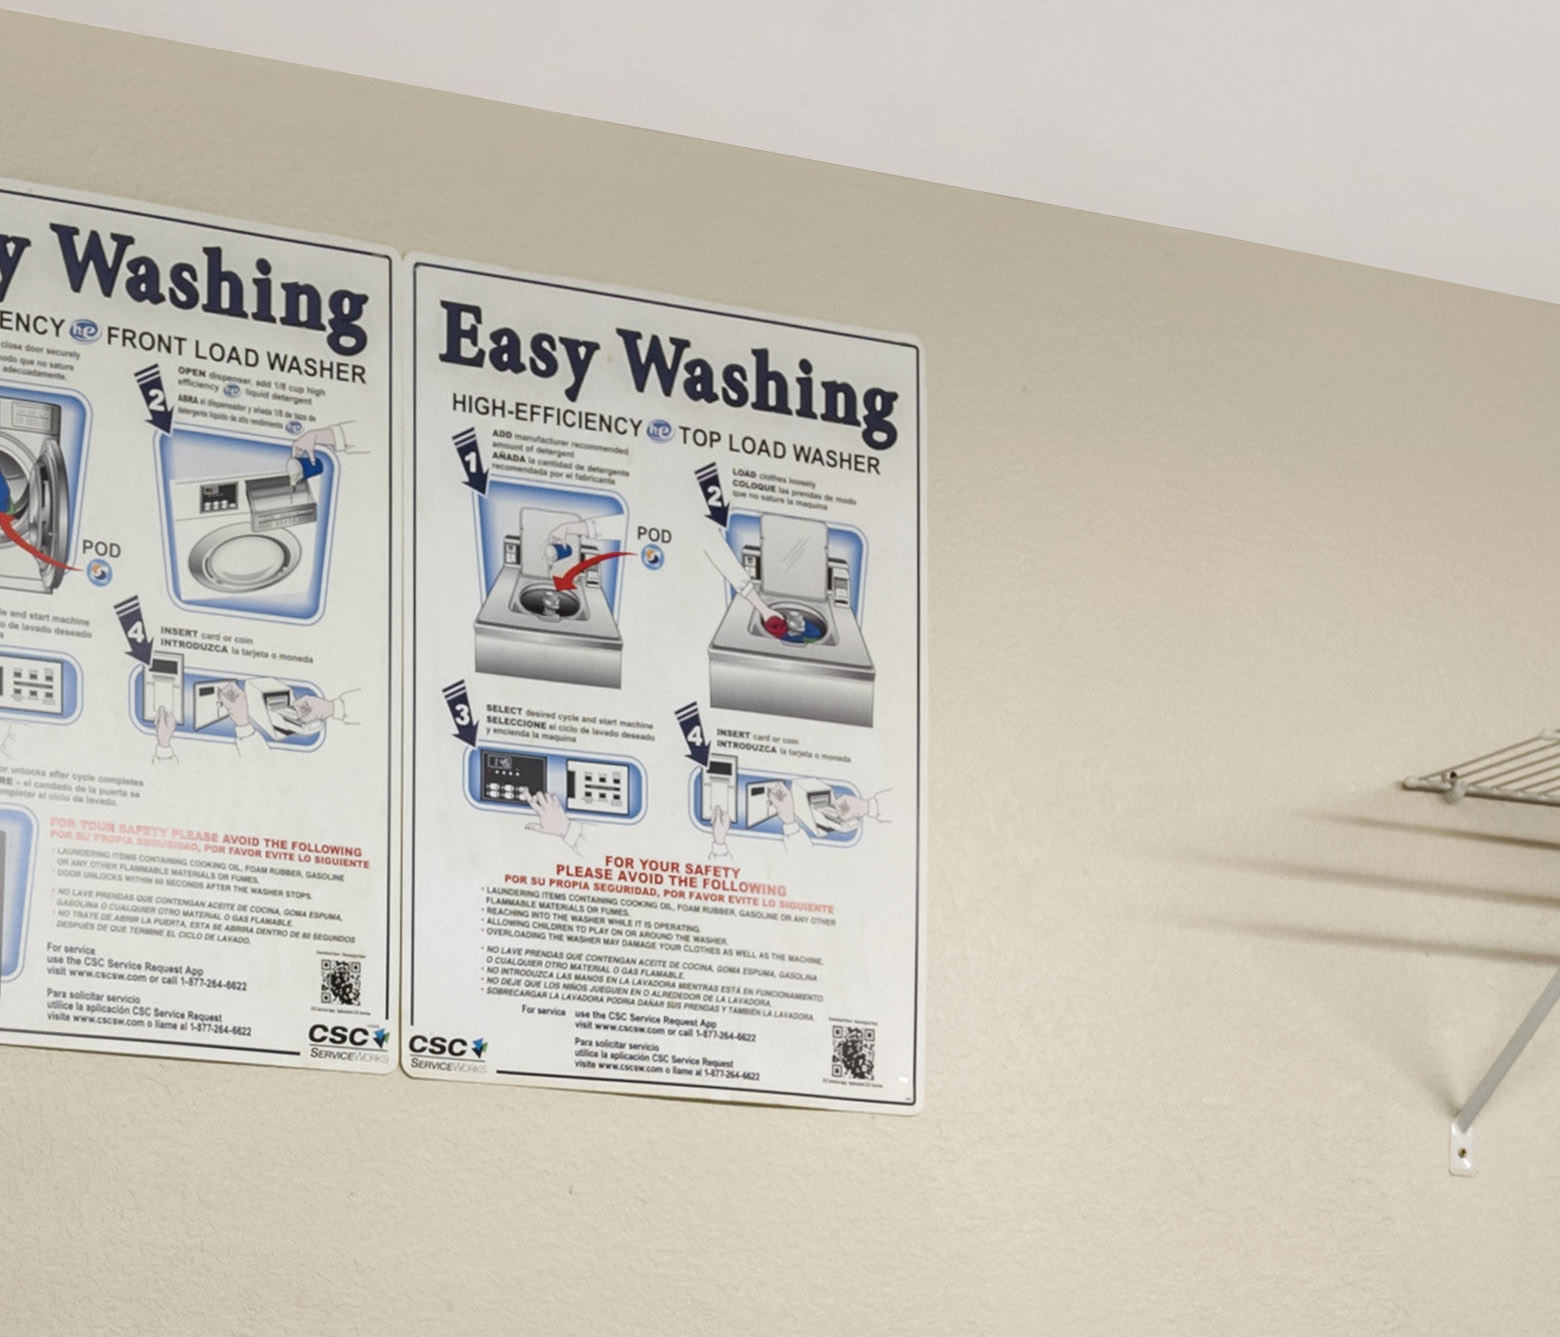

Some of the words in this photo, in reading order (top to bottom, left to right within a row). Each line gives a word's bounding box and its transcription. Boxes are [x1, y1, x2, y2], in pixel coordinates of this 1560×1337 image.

[49, 222, 368, 356] Washing
[107, 325, 187, 355] FRONT
[195, 339, 259, 367] LOAD
[266, 351, 366, 384] WASHER
[438, 300, 600, 402] Easy
[615, 327, 898, 450] Washing
[146, 388, 168, 411] 2
[452, 392, 642, 436] HIGH-EFFICIENCY
[678, 425, 721, 448] TOP
[728, 433, 786, 459] LOAD
[792, 443, 880, 474] WASHER
[463, 451, 476, 472] 1
[707, 485, 724, 506] 2
[637, 525, 672, 543] POD
[82, 539, 121, 558] POD
[124, 619, 146, 643] 4
[160, 626, 197, 637] INSERT
[453, 703, 472, 726] 3
[486, 703, 522, 714] SELECT
[685, 724, 705, 746] 4
[223, 835, 259, 846] AVOID
[263, 838, 286, 849] THE
[290, 841, 362, 856] FOLLOWING
[604, 855, 634, 868] FOR
[640, 859, 679, 872] YOUR
[685, 863, 739, 877] SAFETY
[555, 863, 611, 880] PLEASE
[617, 869, 664, 885] AVOID
[669, 873, 697, 887] THE
[702, 877, 784, 895] FOLLOWING
[308, 1024, 368, 1046] CSC
[408, 1034, 468, 1057] CSC
